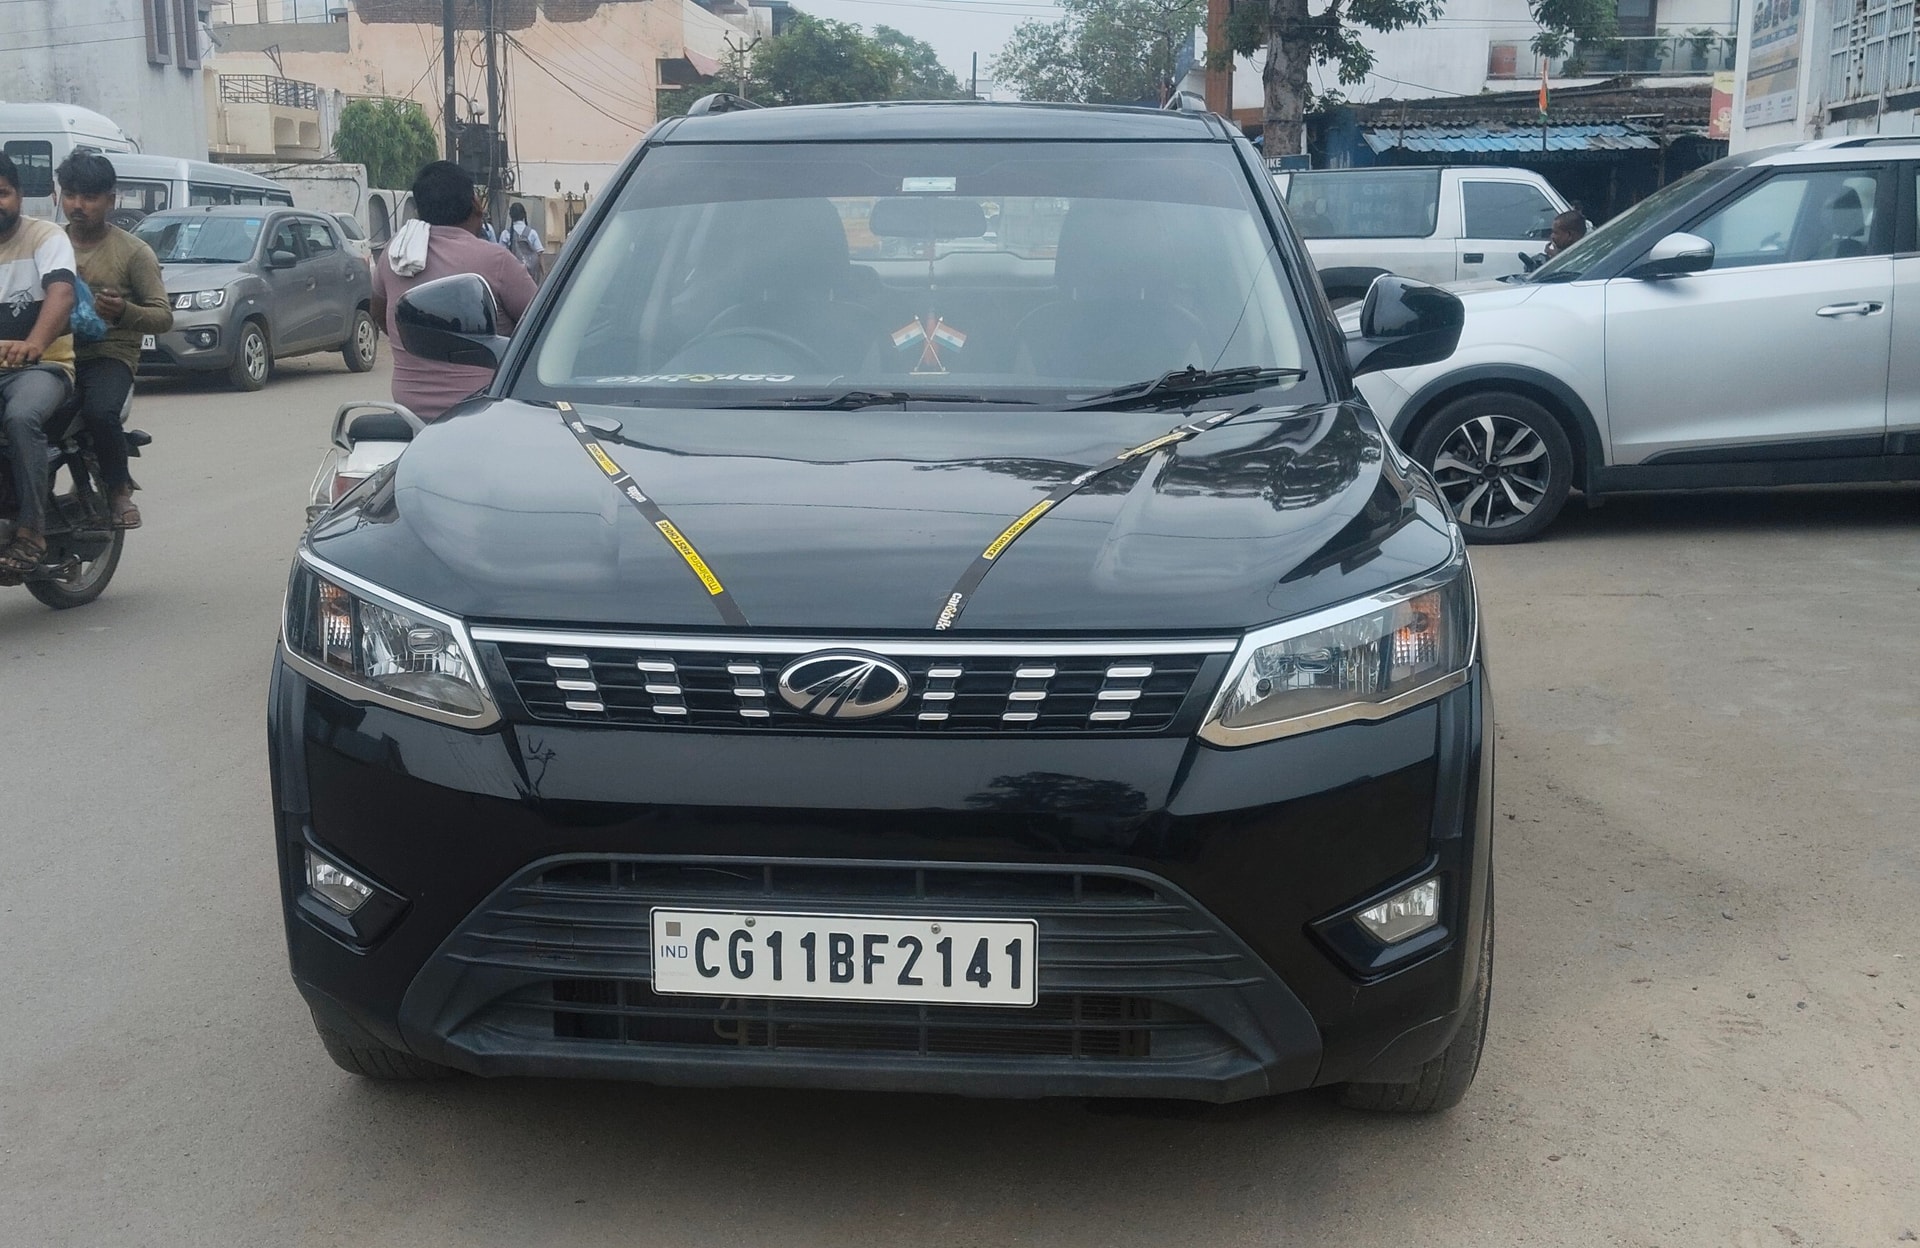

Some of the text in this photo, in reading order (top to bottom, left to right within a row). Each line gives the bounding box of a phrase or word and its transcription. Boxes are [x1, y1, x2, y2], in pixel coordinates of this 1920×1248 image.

[1518, 149, 1565, 161] WORKS
[1264, 158, 1281, 168] IKE
[658, 521, 680, 541] CHOICE
[674, 540, 693, 556] FIRST
[661, 945, 688, 958] IND
[695, 928, 1022, 989] CG11BF2141
